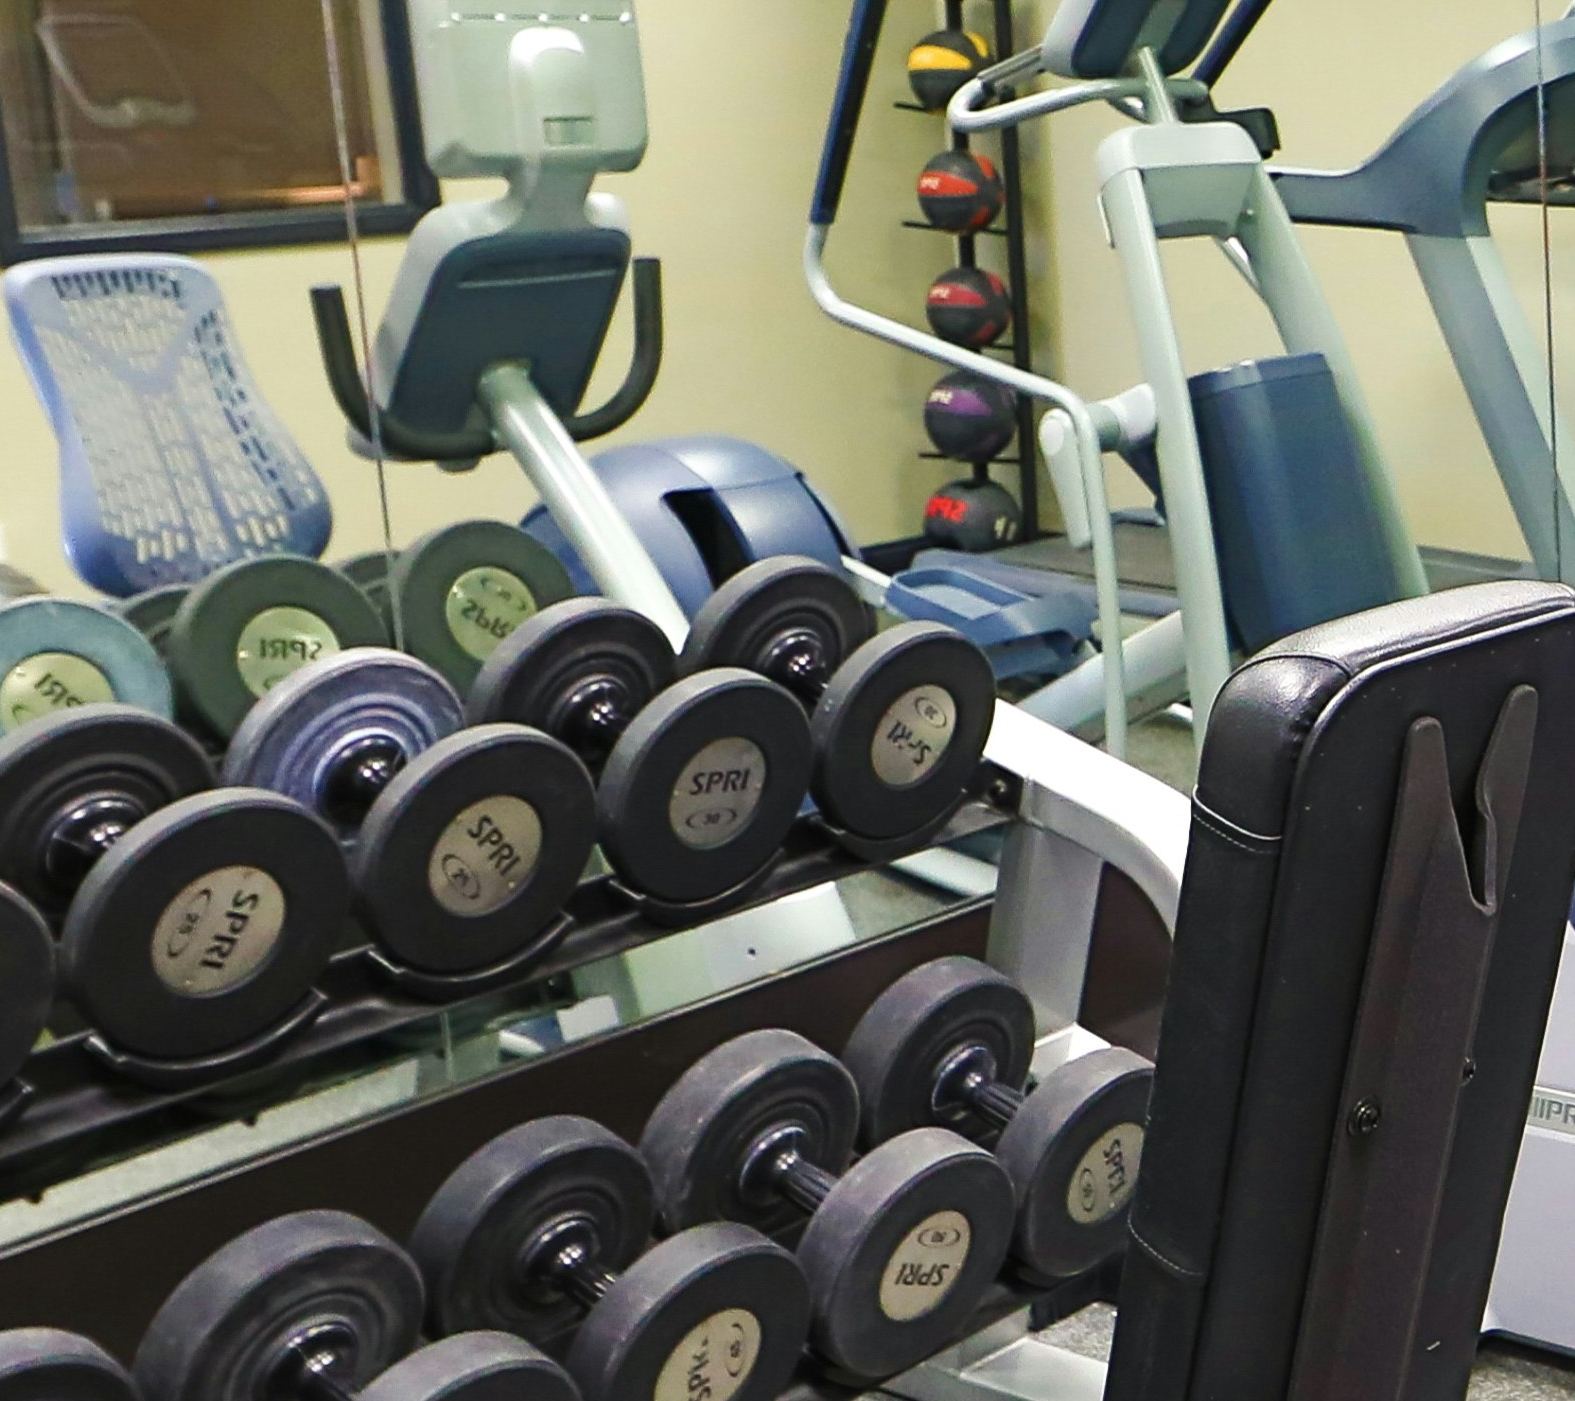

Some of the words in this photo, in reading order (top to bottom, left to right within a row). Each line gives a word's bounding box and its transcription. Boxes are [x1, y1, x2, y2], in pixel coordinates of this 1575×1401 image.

[689, 767, 751, 796] SPRI
[467, 815, 521, 876] SPRI
[200, 890, 259, 969] SPRI
[895, 1263, 950, 1287] SPRI
